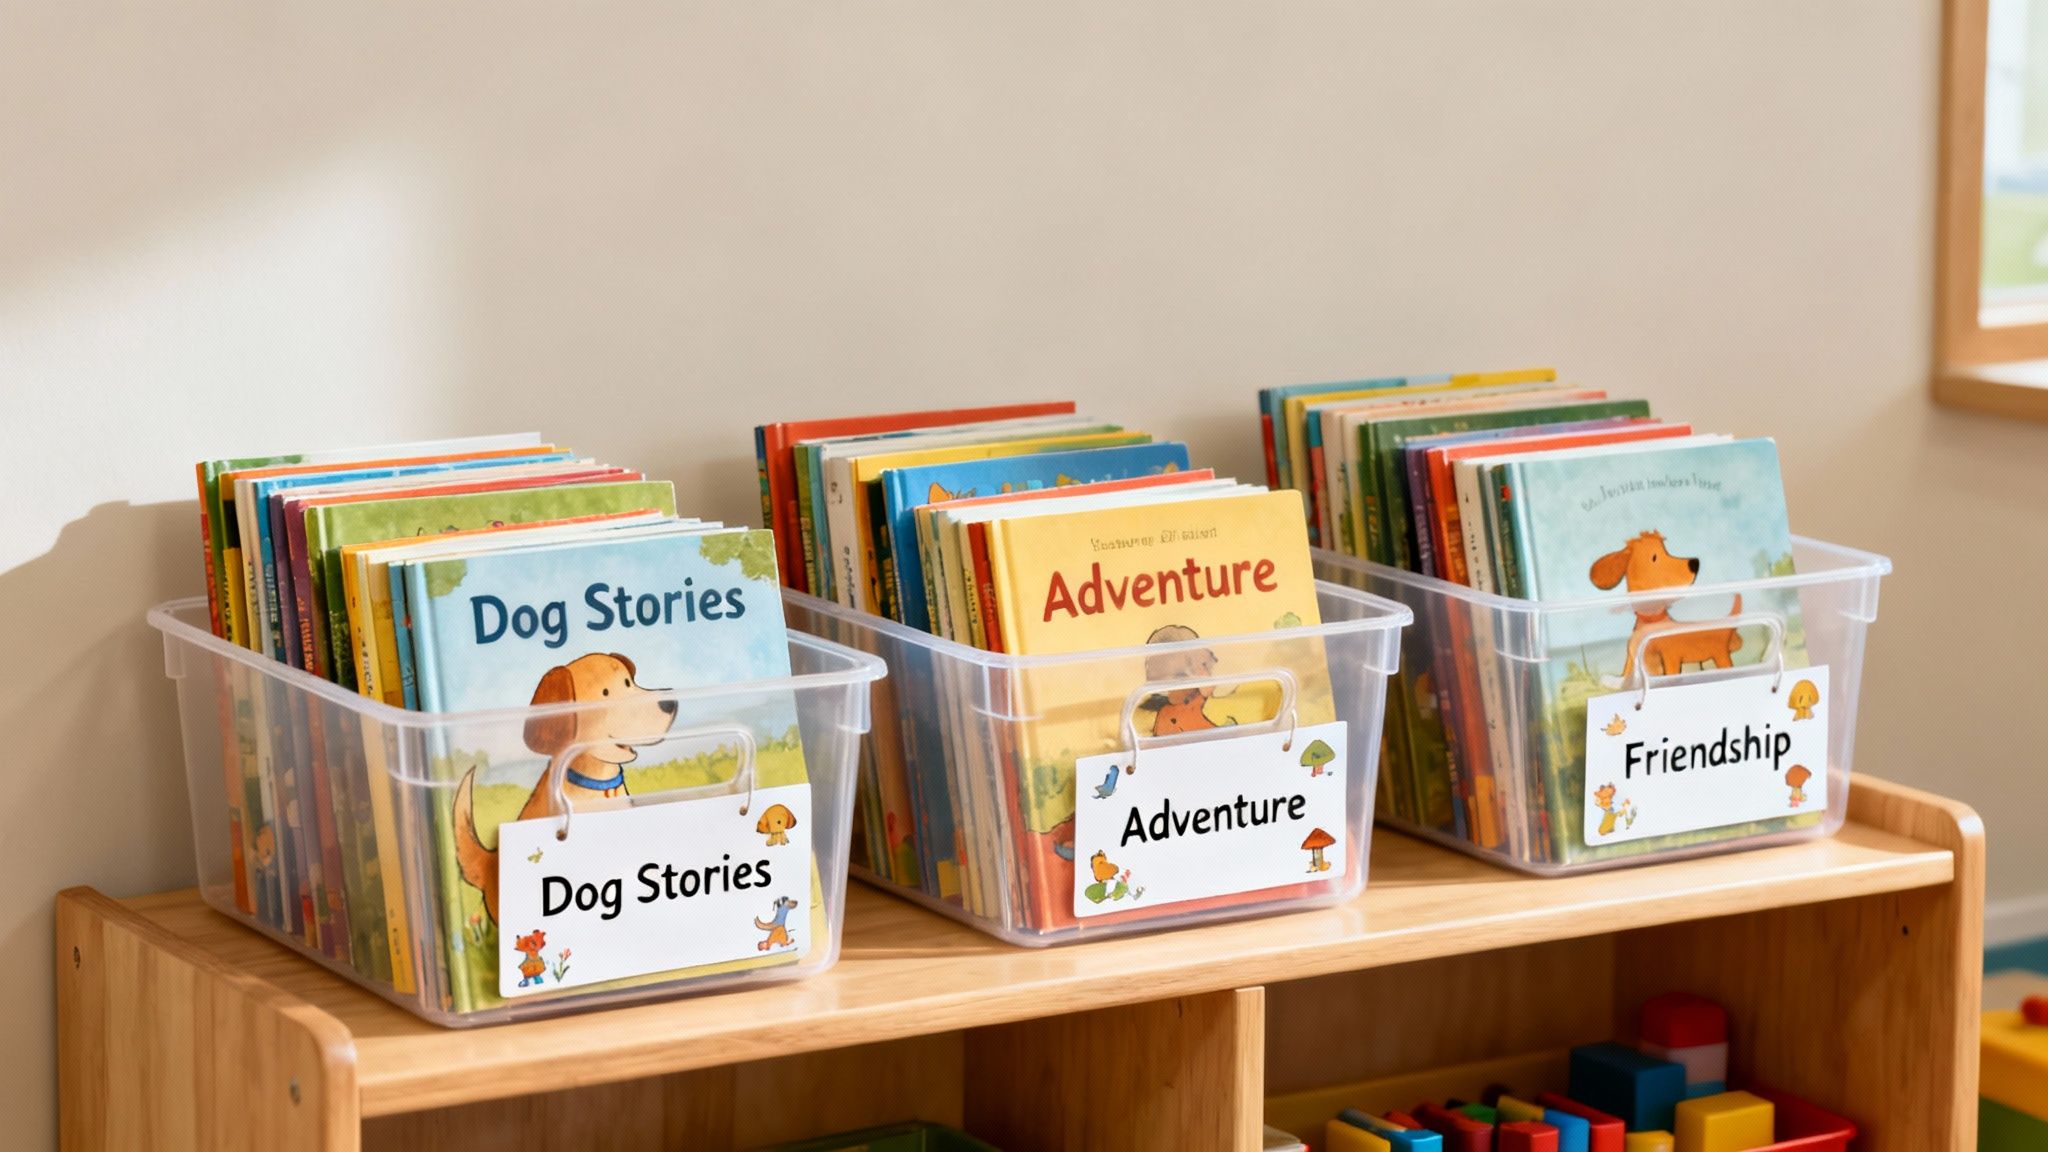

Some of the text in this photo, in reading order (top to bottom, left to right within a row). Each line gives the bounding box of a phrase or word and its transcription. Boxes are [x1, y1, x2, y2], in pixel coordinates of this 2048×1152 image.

[469, 576, 746, 649] Dog Stories
[1043, 558, 1278, 622] Adventure
[1625, 725, 1791, 779] Friendship
[1120, 794, 1306, 848] Adventure
[542, 853, 772, 921] Dog Stories
